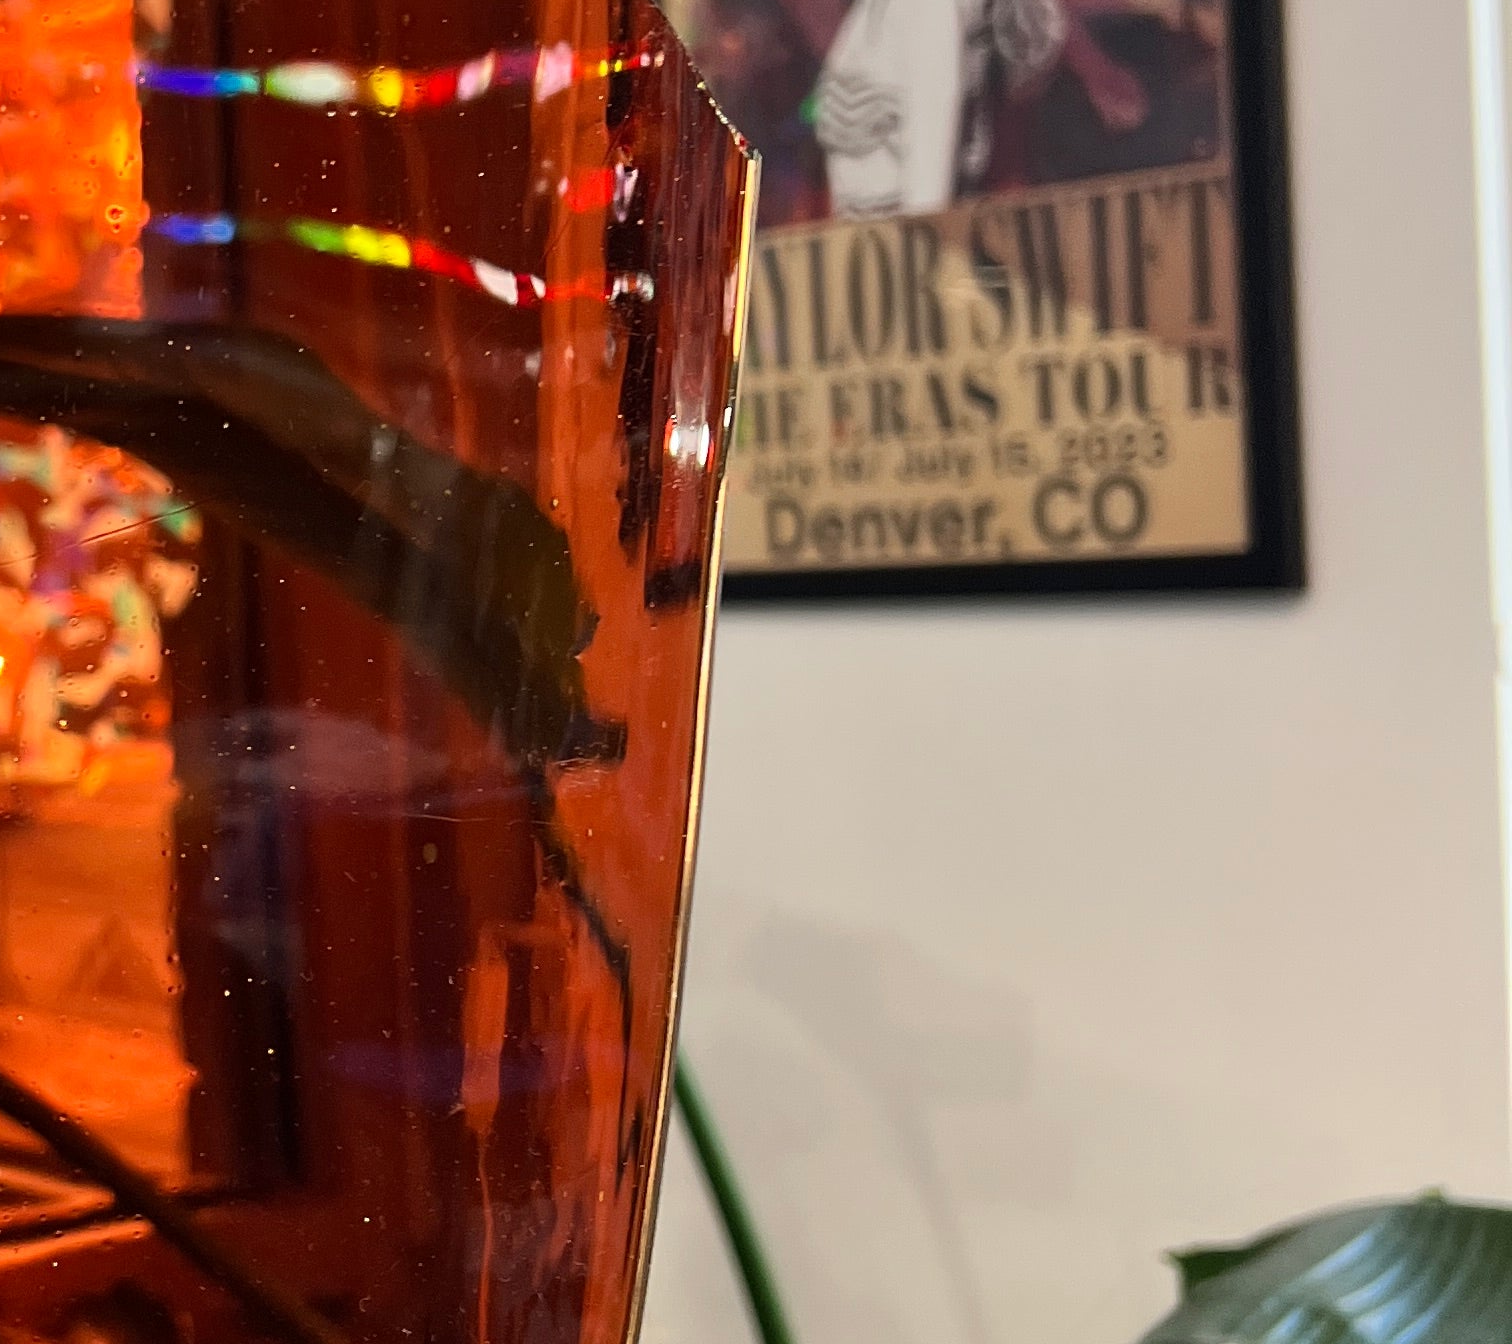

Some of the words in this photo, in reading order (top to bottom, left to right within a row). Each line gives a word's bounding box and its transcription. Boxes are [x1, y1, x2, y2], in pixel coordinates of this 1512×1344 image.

[968, 180, 1236, 350] SWIFT
[824, 366, 1002, 446] ERAS
[1016, 342, 1236, 429] TOUR
[764, 494, 1015, 560] Denver,
[1030, 473, 1148, 548] CO
